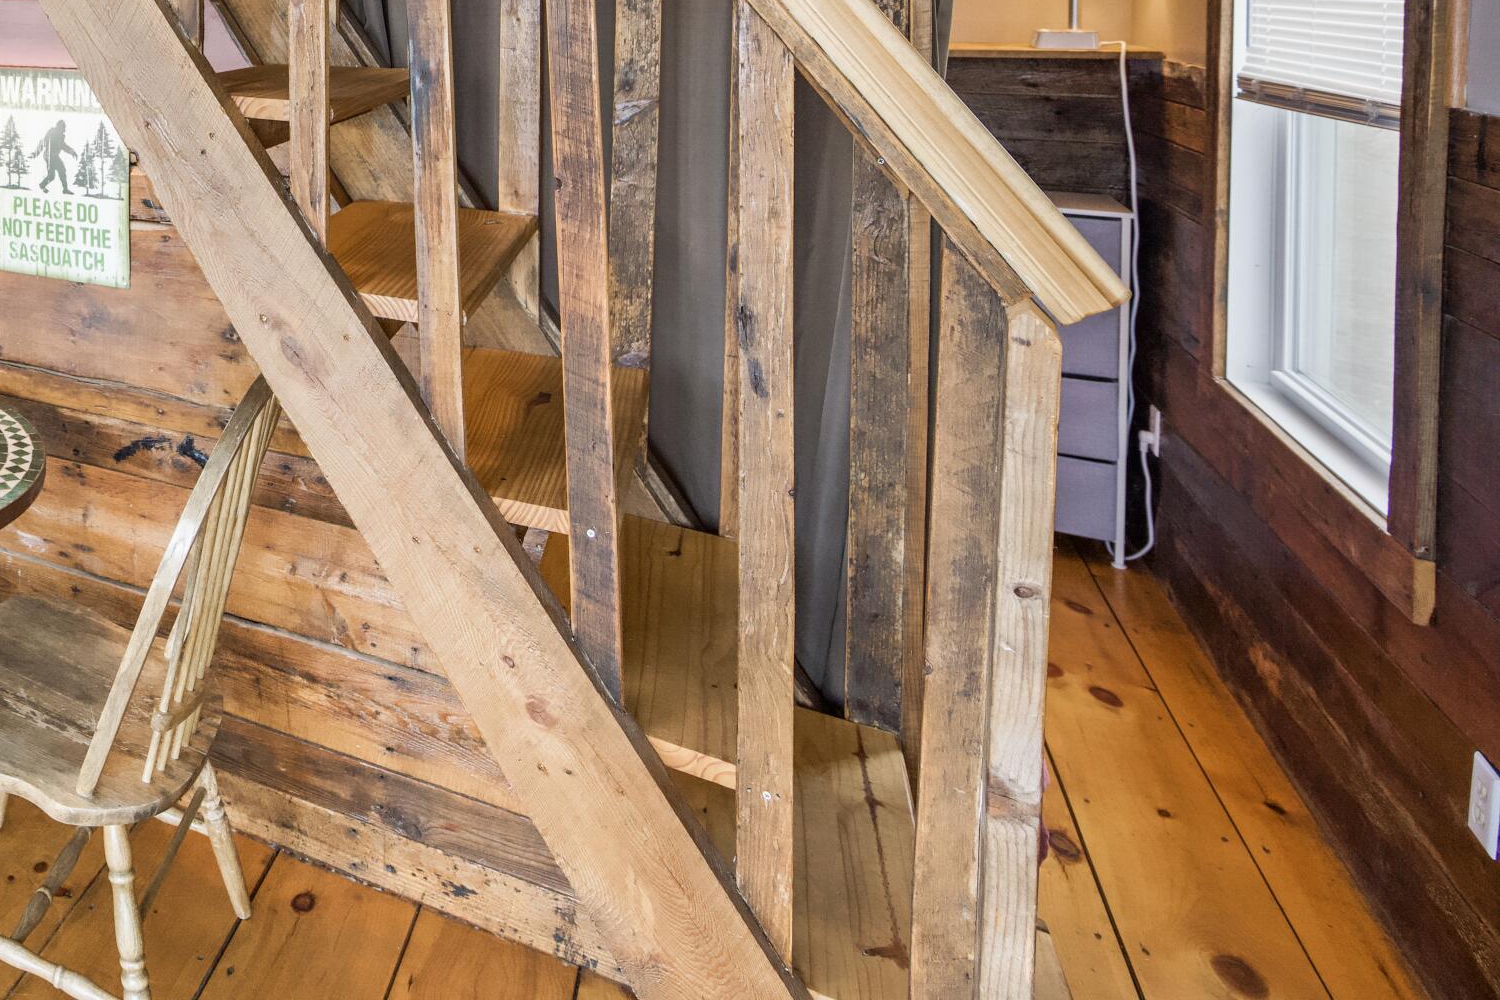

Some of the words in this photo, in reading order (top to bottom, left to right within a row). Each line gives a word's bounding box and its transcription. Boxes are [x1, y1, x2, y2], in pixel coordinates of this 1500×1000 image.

[13, 196, 73, 220] PLEASE
[77, 203, 98, 223] DO
[2, 217, 32, 238] NOT
[36, 221, 76, 244] FEED
[79, 226, 111, 249] THE
[9, 241, 105, 272] SASQUATCH
